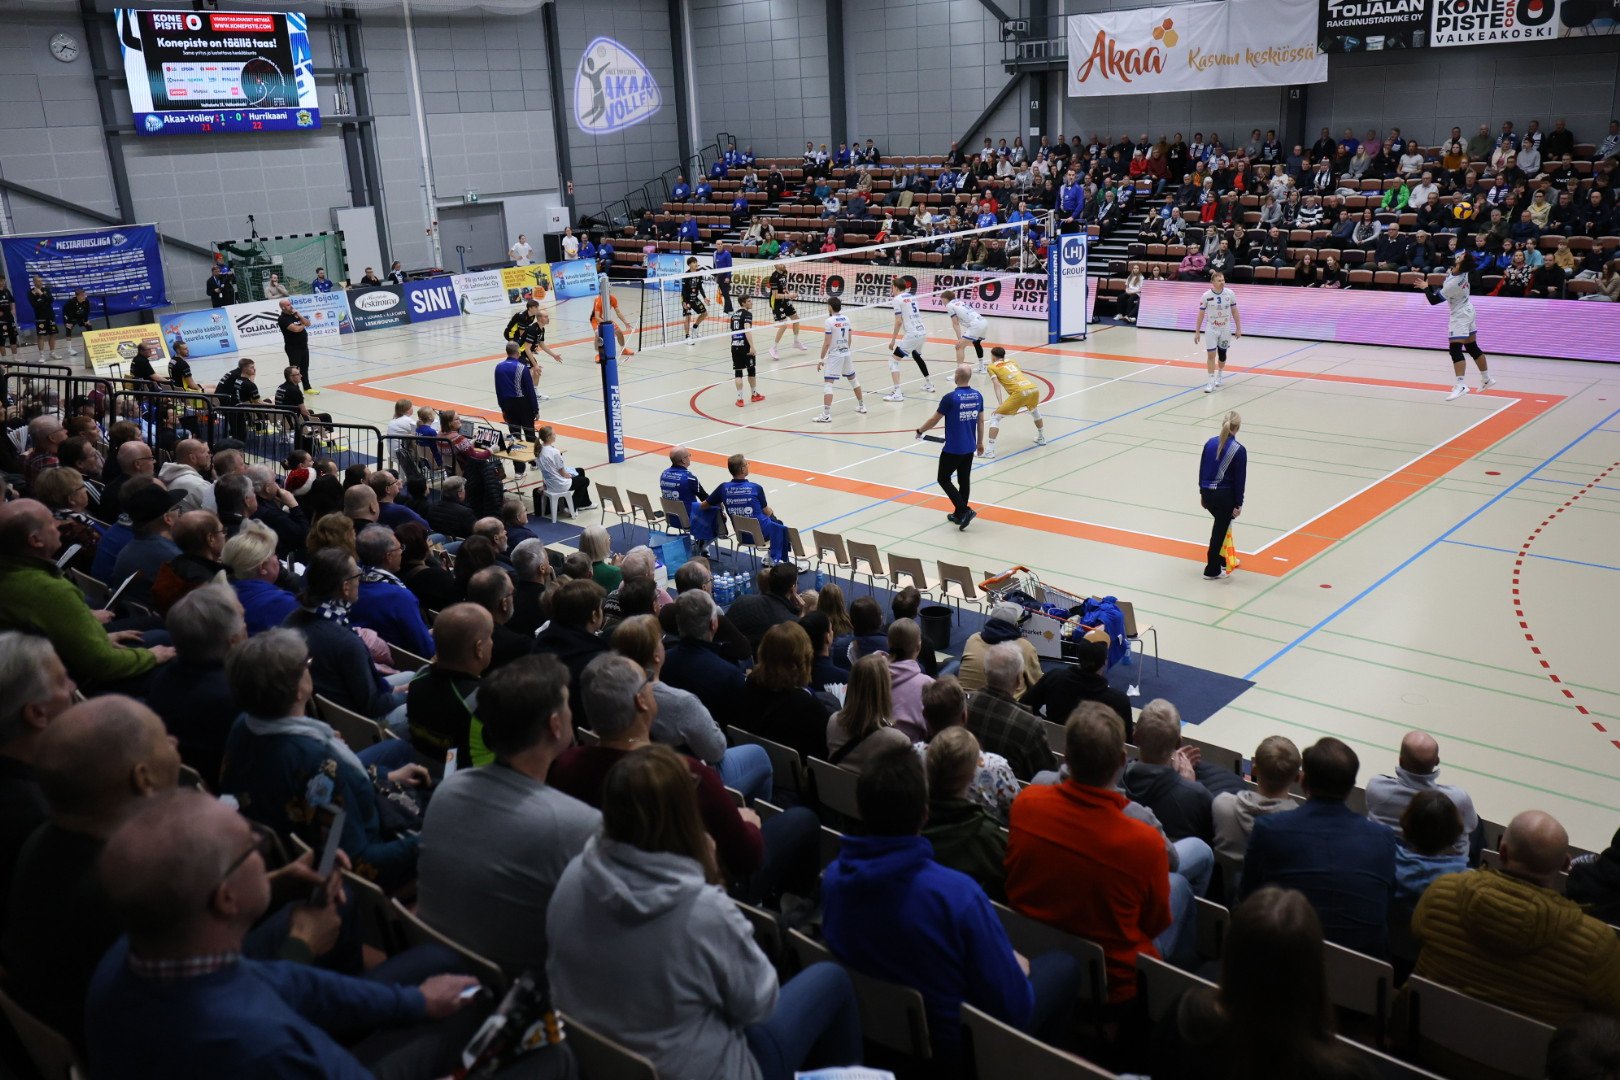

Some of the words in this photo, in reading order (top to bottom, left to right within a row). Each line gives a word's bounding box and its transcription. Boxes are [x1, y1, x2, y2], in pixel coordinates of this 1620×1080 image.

[1328, 0, 1424, 18] TOIJALAN
[1438, 0, 1504, 15] KONE
[153, 14, 182, 22] KONE
[1327, 15, 1409, 28] RAKENNUSTARVIKE
[1411, 13, 1423, 21] OY
[1436, 13, 1504, 32] PISTE
[155, 22, 183, 30] PISTE
[1436, 27, 1552, 44] VALKEAKOSKI
[156, 38, 206, 50] Konepiste
[209, 40, 222, 48] on
[223, 38, 250, 48] täällä
[252, 39, 278, 48] taas!
[1077, 29, 1168, 83] Akaa
[1187, 49, 1240, 72] Kasvun
[1245, 43, 1316, 68] keskiössä
[605, 75, 650, 100] AKAA
[605, 88, 654, 128] VOLLEY
[163, 113, 214, 123] Akaa-Volley
[249, 112, 287, 120] Hurrikaani
[56, 236, 111, 250] MESTARUUSLIIGA
[1064, 245, 1083, 260] LHJ
[1062, 267, 1085, 275] GROUP
[788, 273, 822, 284] KONE
[856, 273, 892, 285] KONE
[1015, 278, 1048, 291] KON
[788, 284, 820, 296] PISTE
[855, 285, 891, 298] PISTE
[314, 294, 340, 303] Toijala
[411, 286, 452, 314] SINI
[1013, 291, 1048, 303] PIST
[1216, 296, 1222, 304] 3
[911, 302, 918, 313] 5
[840, 328, 846, 338] 7
[611, 385, 624, 458] PESMENPOL
